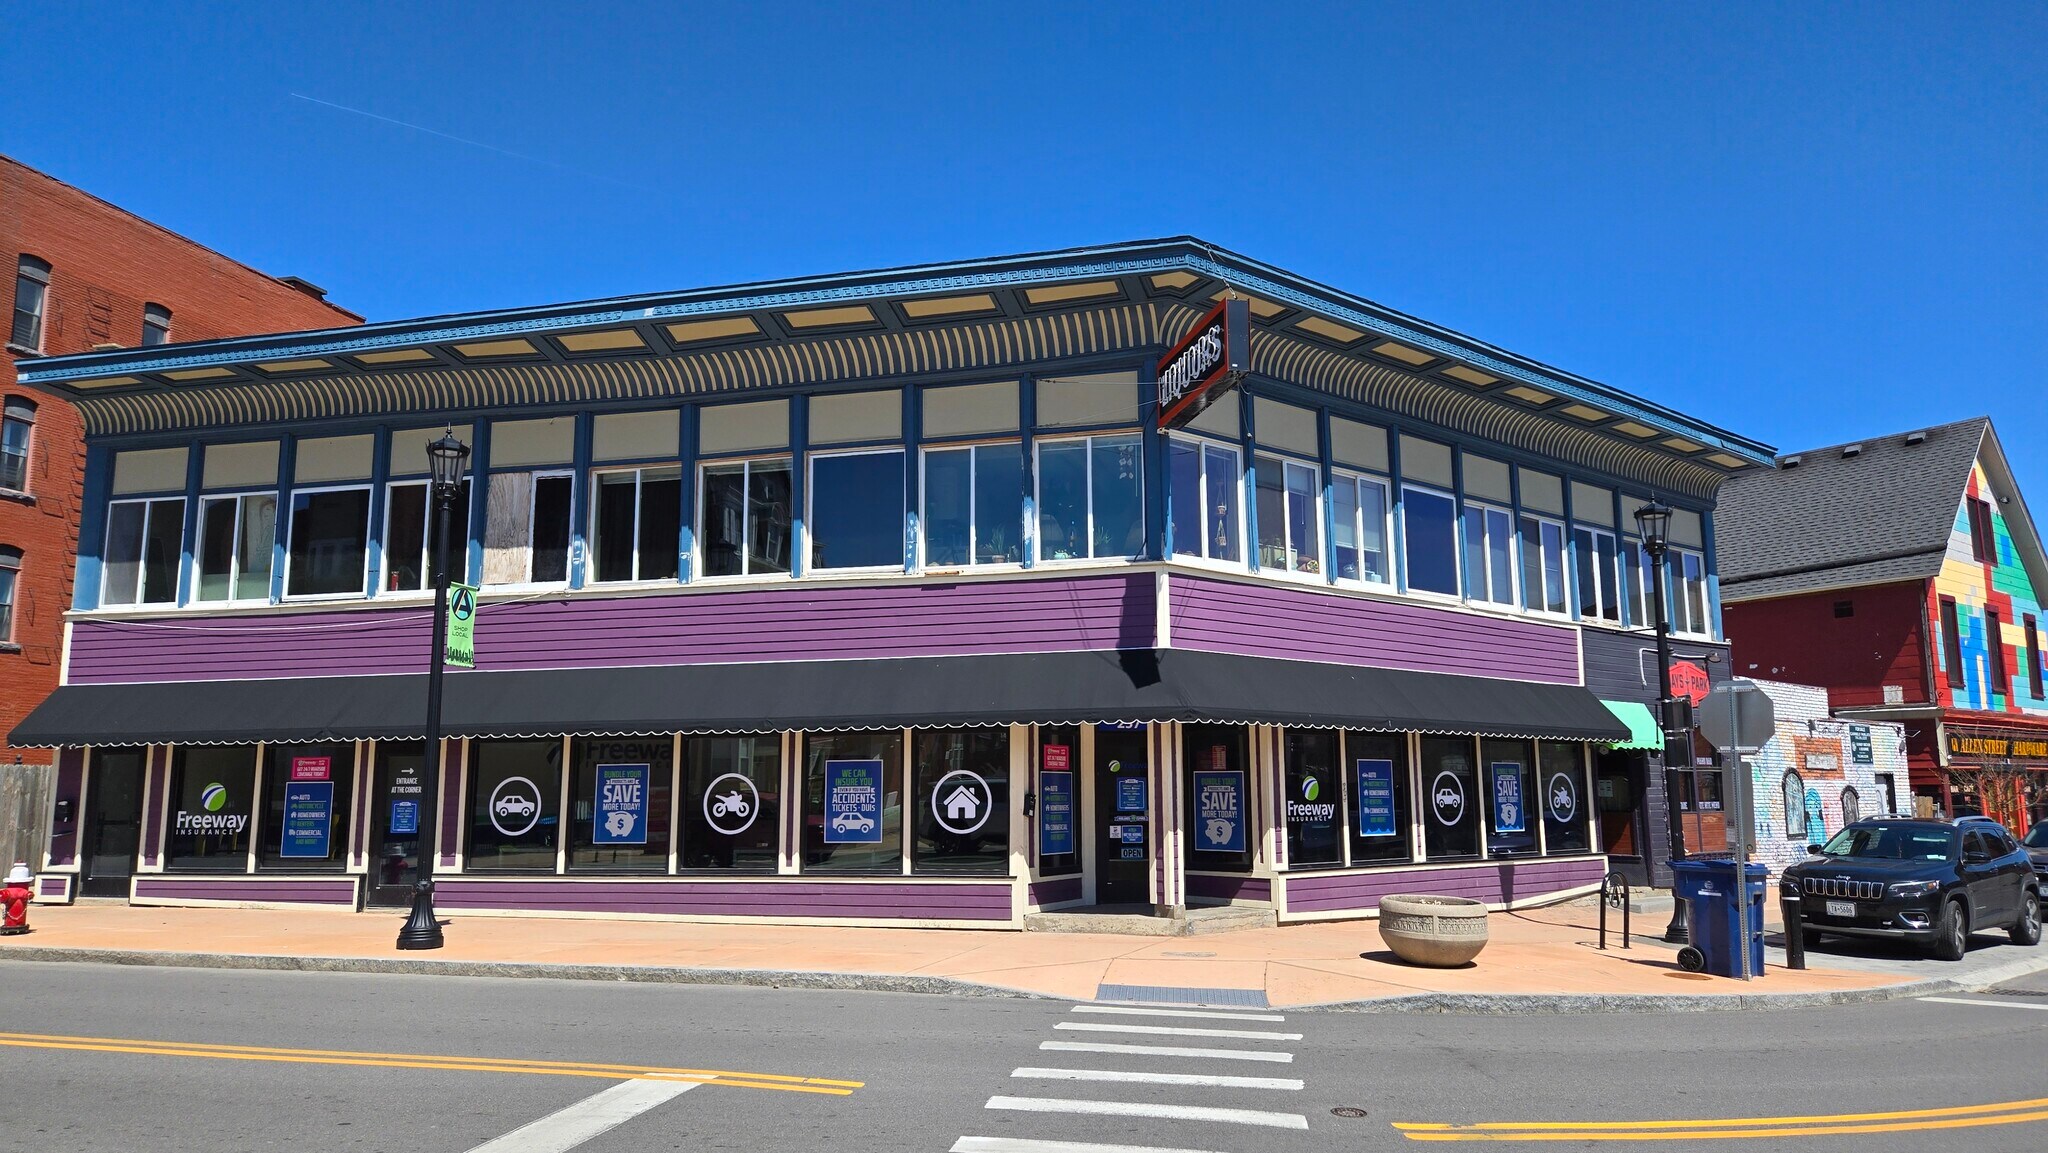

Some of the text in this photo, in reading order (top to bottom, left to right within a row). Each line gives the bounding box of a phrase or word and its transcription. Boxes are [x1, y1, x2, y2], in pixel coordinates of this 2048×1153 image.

[1158, 325, 1222, 407] LIQUORS
[1671, 673, 1708, 691] AYS PARK
[1960, 737, 2048, 757] ALLEN STREET HARDWARE
[604, 770, 641, 778] BUNDLE YOUR
[842, 769, 866, 778] WE CAN
[396, 777, 418, 785] ENTRANCE
[835, 777, 873, 786] INSURE YOU
[391, 786, 397, 794] AT
[405, 786, 422, 794] CORNER
[603, 784, 641, 803] SAVE
[1497, 780, 1518, 796] SAVE
[832, 793, 876, 804] ACCIDENTS
[1201, 792, 1237, 811] SAVE
[602, 802, 641, 811] MORE TODAY!
[832, 803, 876, 812] TICKETS DUIs
[1287, 800, 1335, 819] Freeway
[1218, 810, 1238, 819] TODAY!
[176, 810, 248, 833] Freeway
[617, 818, 624, 830] $
[1216, 826, 1223, 838] $
[1123, 849, 1142, 858] OPEN
